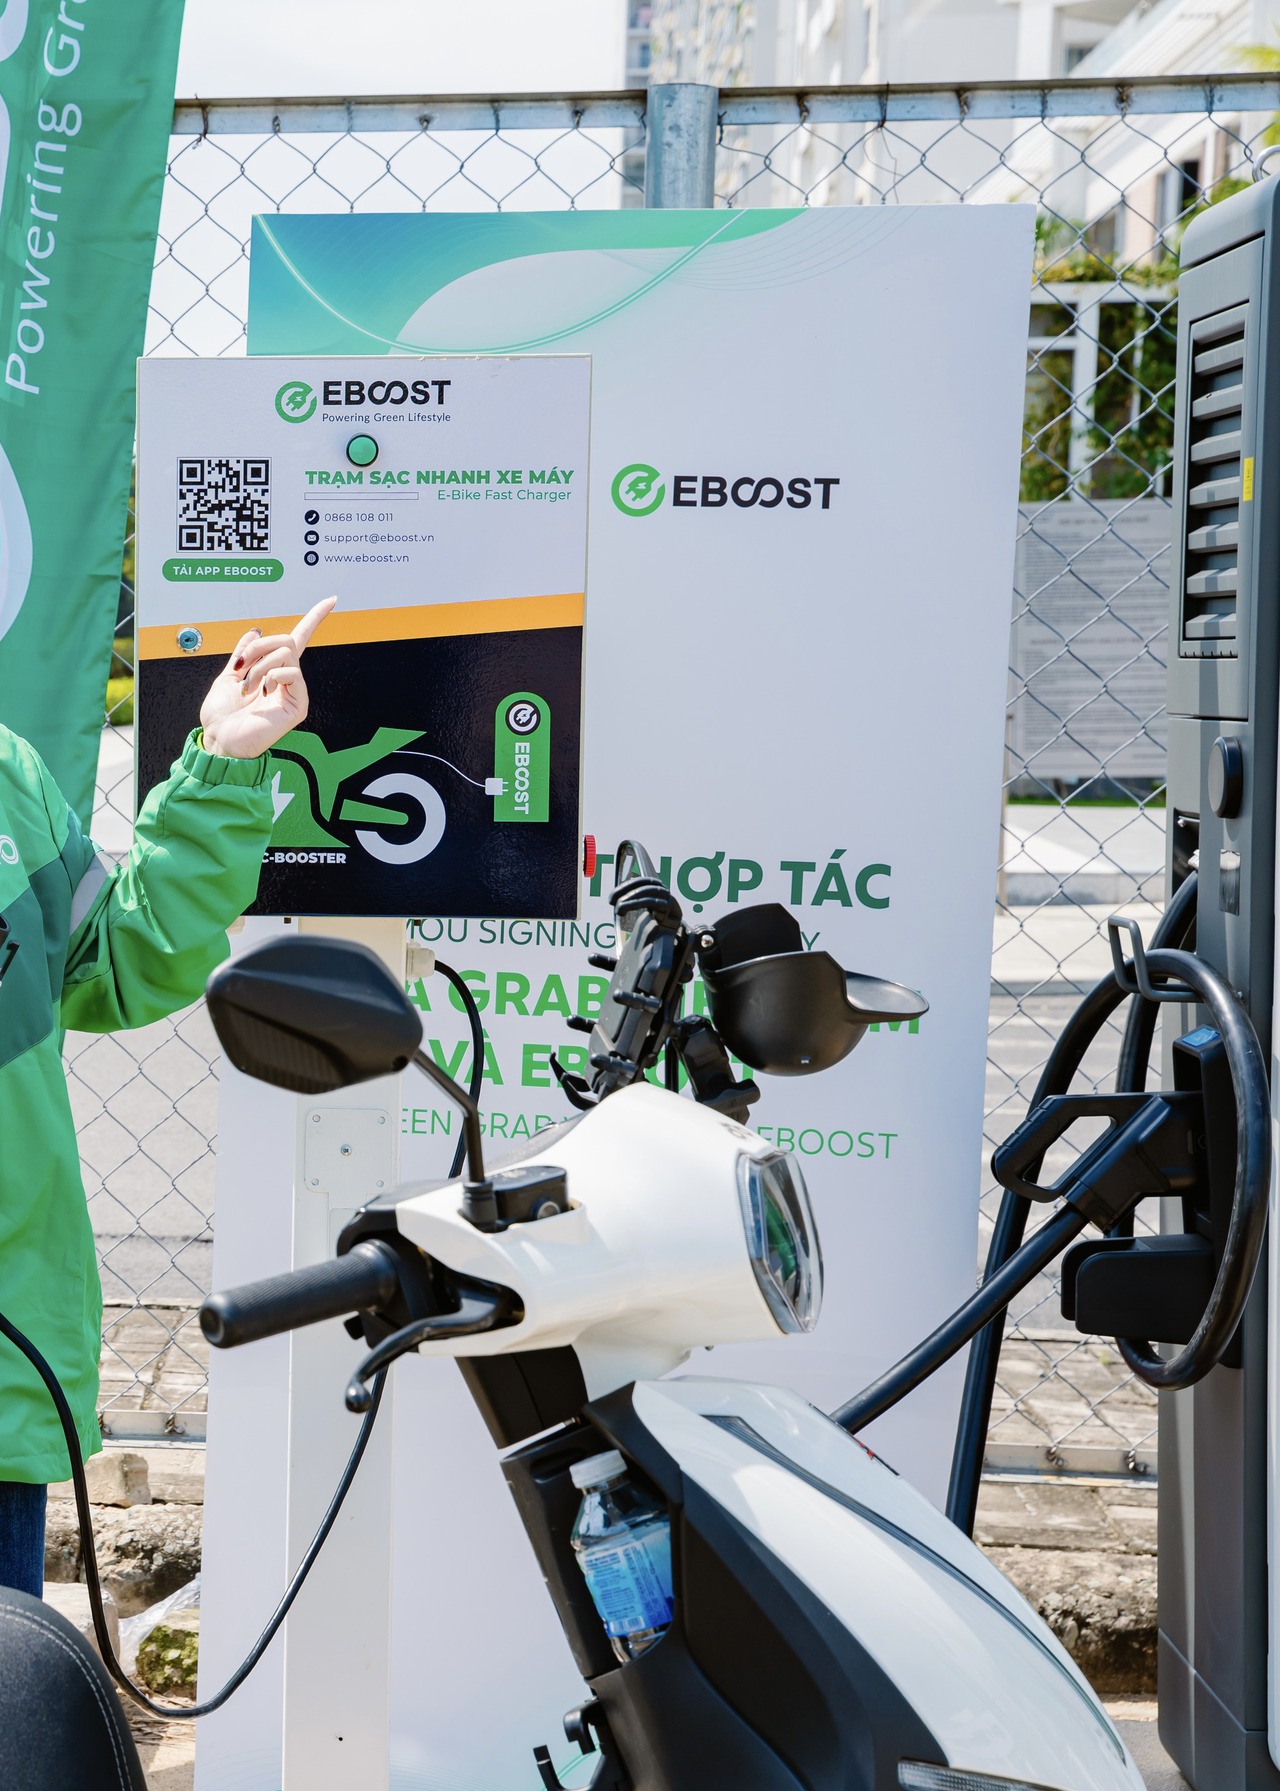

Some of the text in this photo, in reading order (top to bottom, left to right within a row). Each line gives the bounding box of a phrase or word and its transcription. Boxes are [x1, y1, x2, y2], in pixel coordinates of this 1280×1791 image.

[4, 0, 87, 395] Powering Gr
[323, 380, 452, 406] EBOOST
[322, 412, 451, 424] Powering Green Lifestyle
[305, 466, 575, 489] TRẠM SẠC NHANH XE MÁY
[437, 489, 572, 503] E-Bike Fast Charger
[672, 475, 841, 510] EBOOST
[324, 512, 394, 522] 0868 108 011
[324, 532, 435, 545] support@eboost.vn
[172, 563, 274, 576] TẢI APP EBOOST
[324, 554, 410, 564] www.eboost.vn
[514, 742, 530, 815] EBOOST
[780, 849, 892, 910] TÁC
[479, 919, 617, 949] SIGNING
[428, 1027, 505, 1087] VÀ
